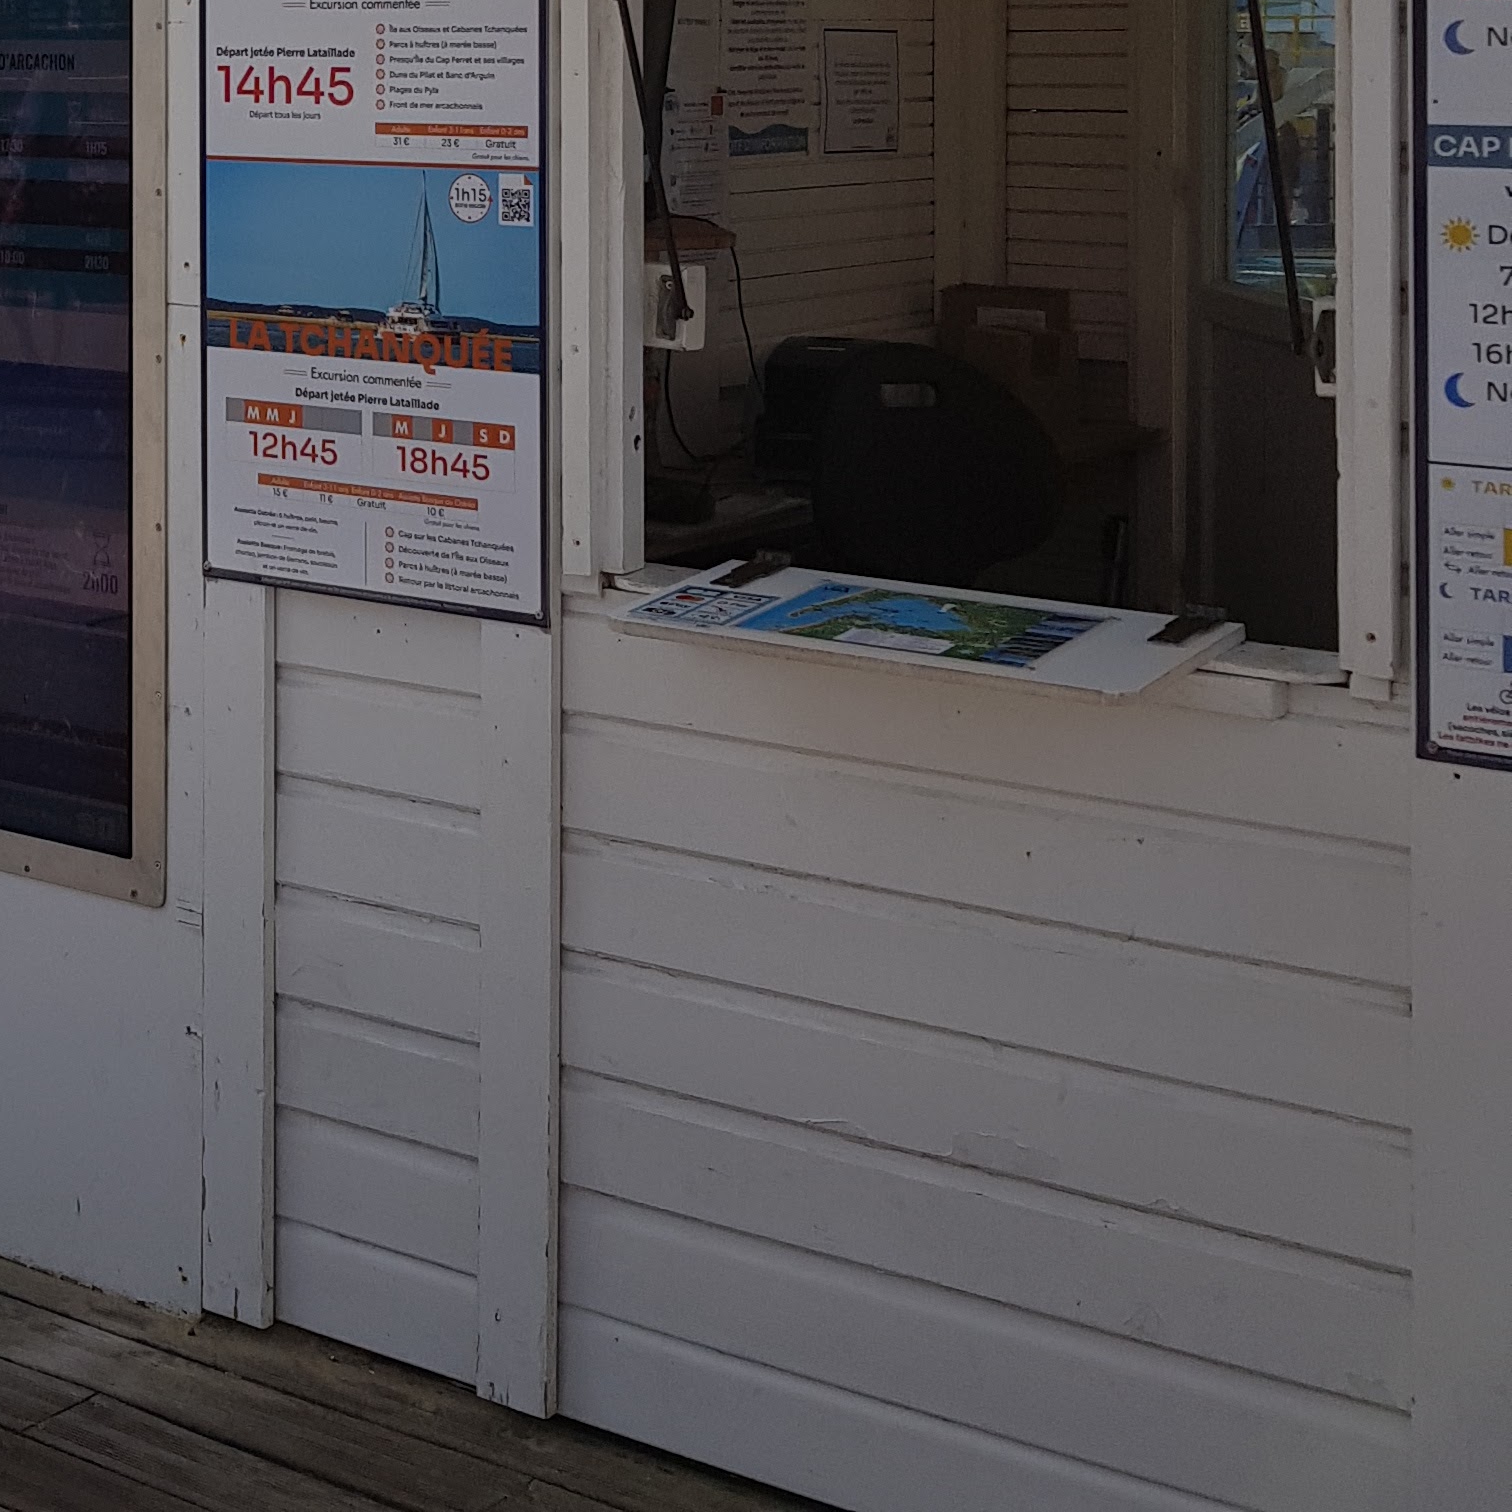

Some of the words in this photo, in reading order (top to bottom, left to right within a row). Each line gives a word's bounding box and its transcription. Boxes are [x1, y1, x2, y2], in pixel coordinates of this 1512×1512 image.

[216, 46, 248, 59] Départ
[276, 46, 305, 58] Pierre
[307, 46, 356, 58] Lataillade
[216, 64, 355, 107] 14h45
[441, 139, 452, 148] 23
[1433, 134, 1501, 159] CAP
[454, 187, 488, 204] 1h15
[1468, 303, 1512, 325] 12h
[228, 317, 272, 352] LA
[278, 324, 513, 376] TCHANQUÉE
[311, 367, 359, 385] Excursion
[362, 372, 422, 389] commentée
[295, 388, 329, 404] Départ
[356, 391, 388, 405] Pierre
[247, 405, 260, 420] M
[266, 406, 280, 423] M
[288, 408, 296, 424] J
[395, 420, 408, 436] M
[438, 424, 446, 438] J
[479, 429, 488, 443] S
[499, 430, 510, 445] D
[248, 431, 339, 466] 12h45
[396, 446, 491, 482] 18h45
[1471, 479, 1512, 496] TAR
[357, 497, 387, 510] Gratuit
[427, 506, 437, 517] 10
[1469, 586, 1512, 604] TAR
